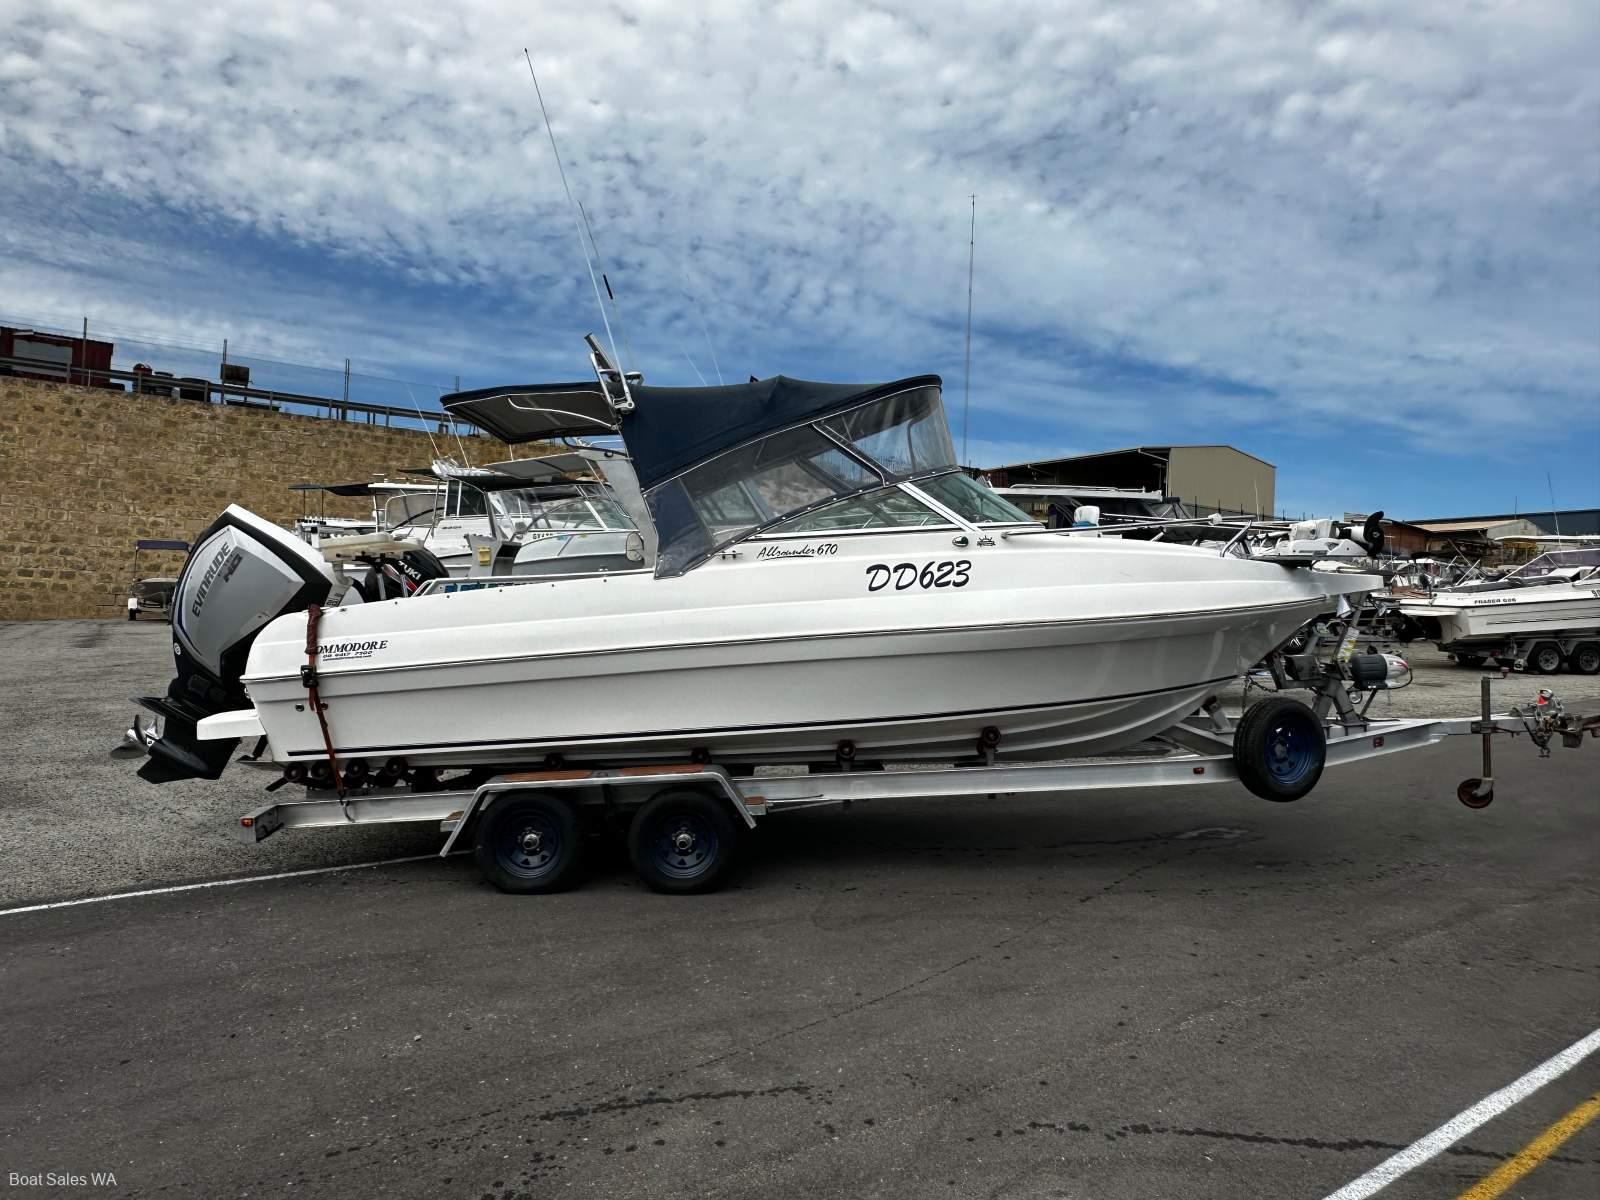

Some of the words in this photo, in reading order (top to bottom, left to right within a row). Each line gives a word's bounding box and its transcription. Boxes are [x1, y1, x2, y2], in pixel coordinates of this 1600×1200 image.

[757, 544, 815, 560] Allrounder
[817, 543, 838, 555] 670
[192, 542, 231, 617] EVINRUDE
[866, 560, 972, 591] DD623
[316, 640, 388, 654] OMMODORE
